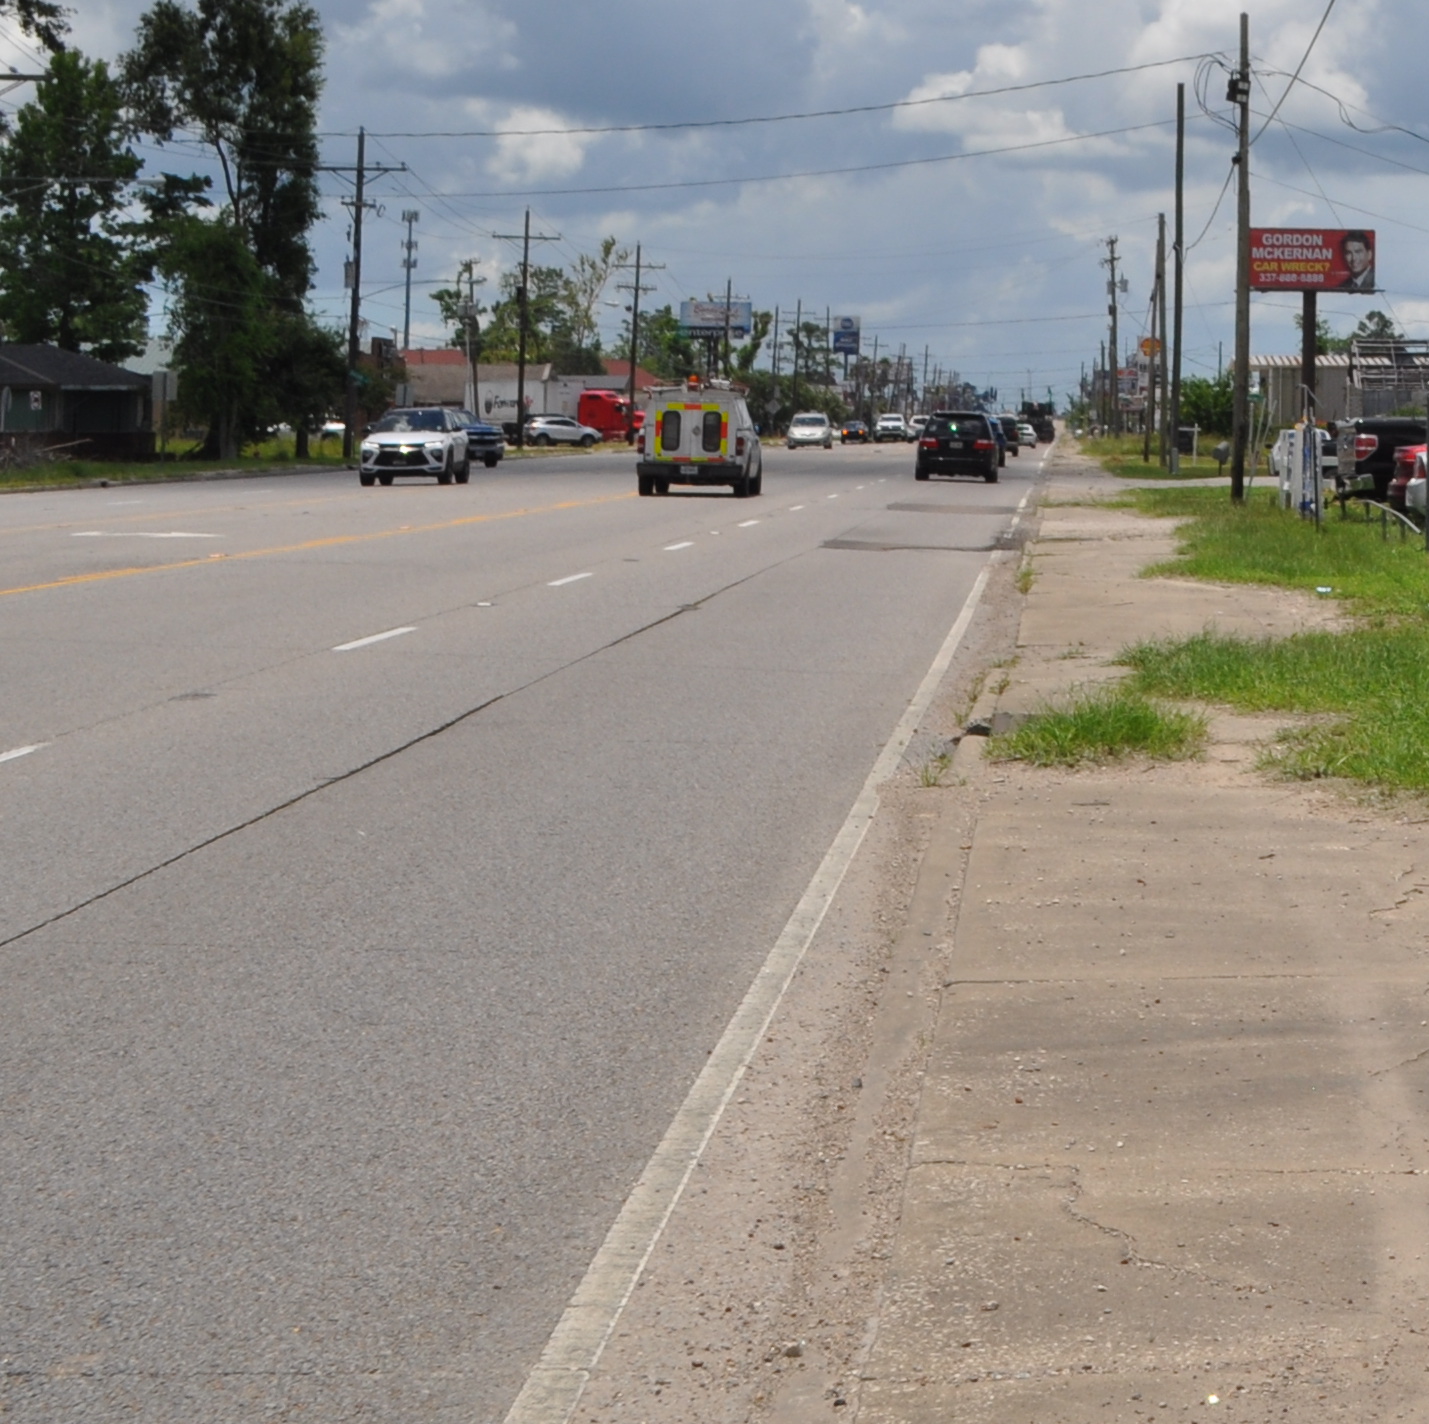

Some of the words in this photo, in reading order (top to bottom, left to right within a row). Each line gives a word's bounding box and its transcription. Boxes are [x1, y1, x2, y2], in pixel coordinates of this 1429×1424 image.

[1262, 233, 1323, 246] GORDON
[1252, 247, 1332, 260] MCKERNAN
[1253, 261, 1278, 271] CAR
[1281, 261, 1331, 272] WRECK?
